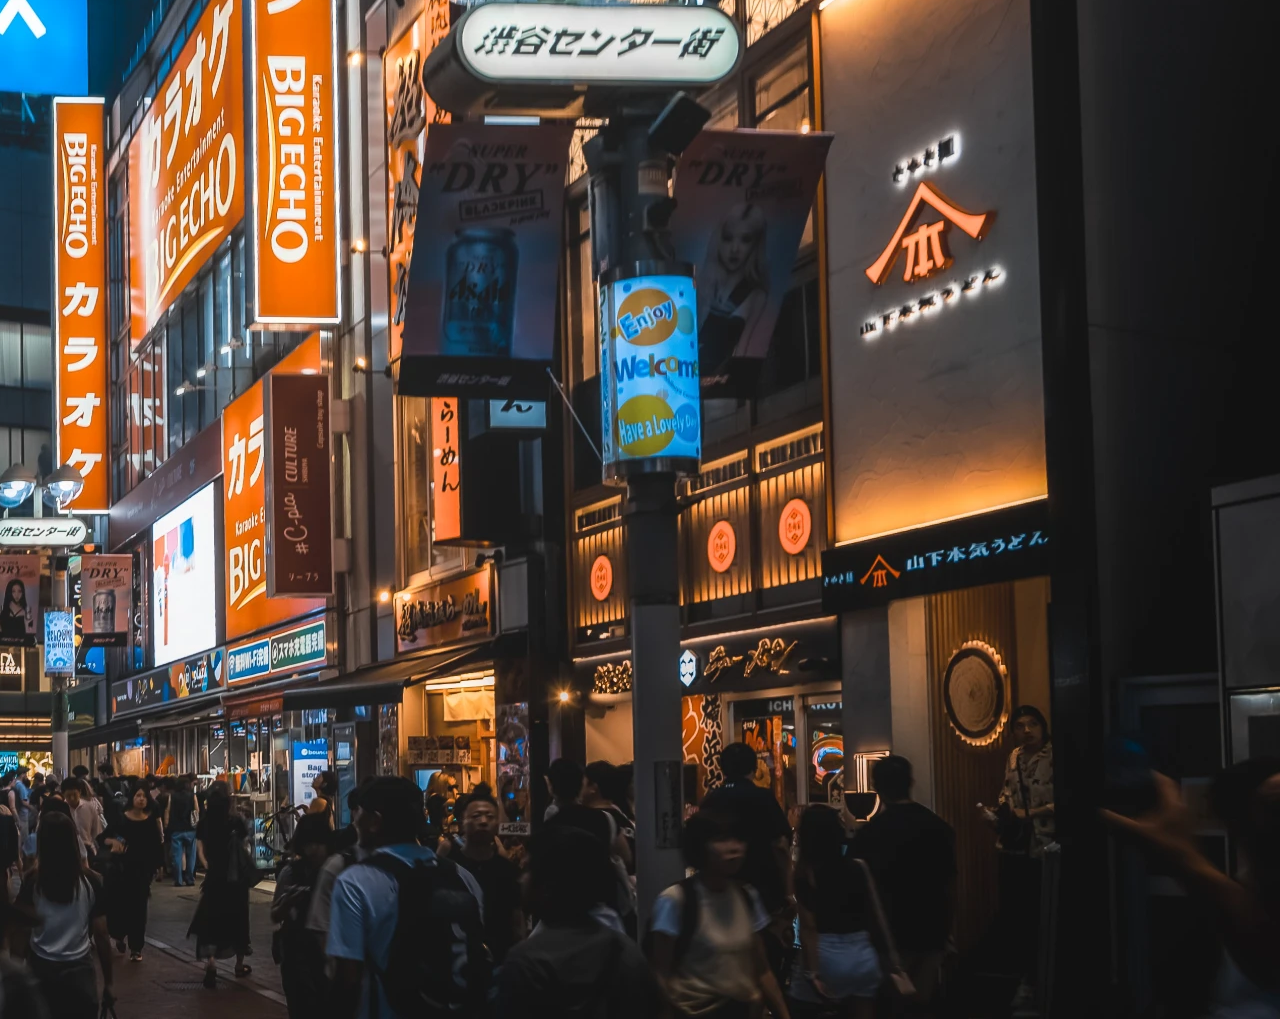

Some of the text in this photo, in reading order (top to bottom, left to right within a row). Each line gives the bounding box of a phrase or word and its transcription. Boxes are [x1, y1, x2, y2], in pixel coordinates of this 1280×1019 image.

[474, 25, 726, 60] 渋谷センター街
[312, 74, 323, 133] Karaoke
[266, 55, 309, 264] BIG ECHO
[63, 132, 89, 259] BIG ECHO
[179, 132, 237, 249] ECHO
[618, 299, 675, 342] Enjoy
[62, 281, 102, 478] カラオケ
[617, 418, 644, 447] Have
[653, 413, 685, 436] Lovely
[284, 425, 298, 483] CULTURE
[906, 531, 1050, 572] 山下本気うどん
[235, 646, 269, 673] 無料Wi-Fi完備
[278, 629, 324, 661] スマホ充電器完備
[307, 764, 322, 772] Bag
